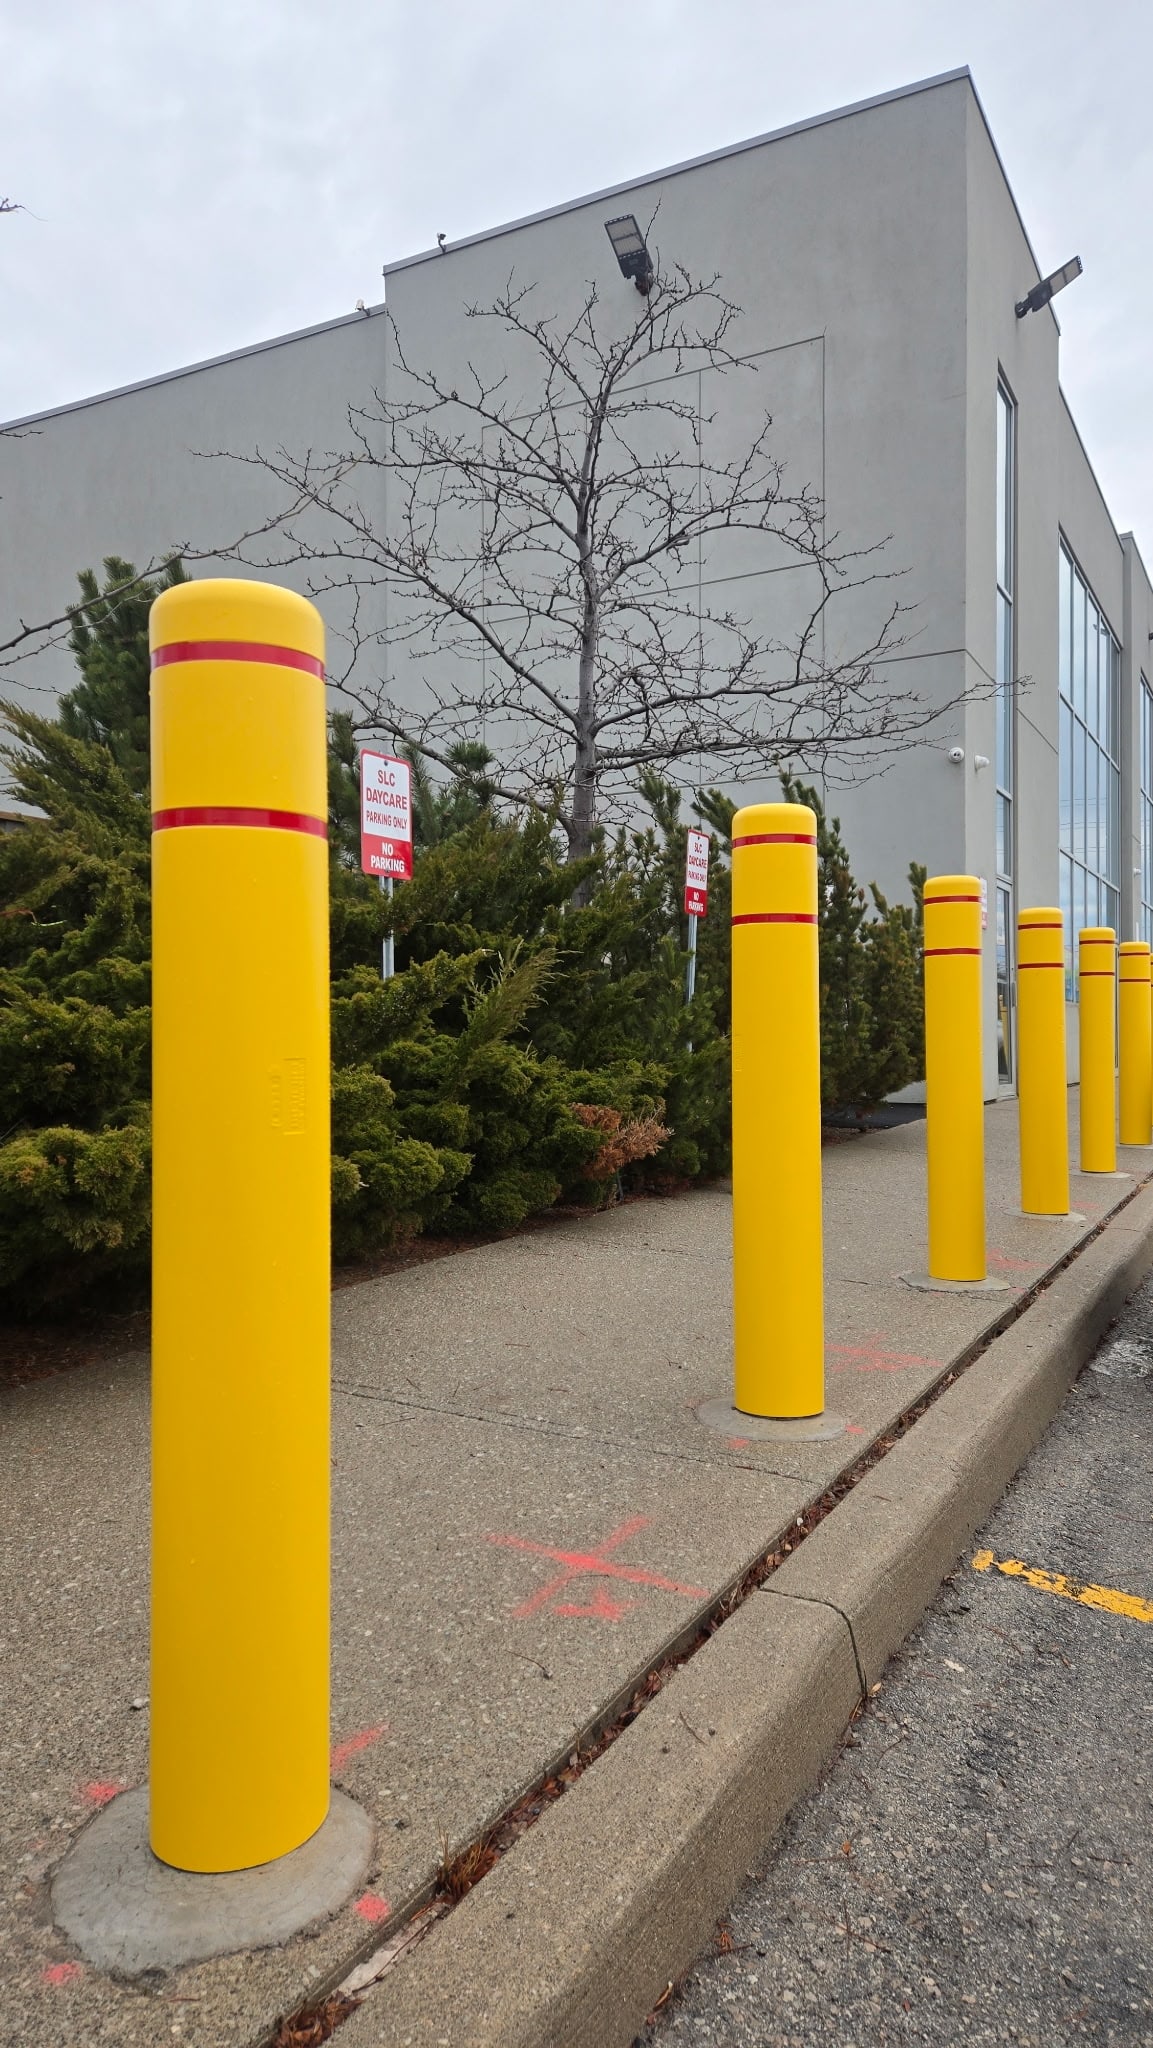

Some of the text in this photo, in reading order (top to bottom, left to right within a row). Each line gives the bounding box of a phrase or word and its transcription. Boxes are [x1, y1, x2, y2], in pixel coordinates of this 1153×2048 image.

[377, 769, 396, 787] SLC
[366, 787, 408, 810] DAYCARE
[366, 810, 408, 830] PARKING ONLY
[381, 842, 394, 856] NO
[370, 855, 405, 873] PARKING
[688, 855, 707, 869] DAYCARE
